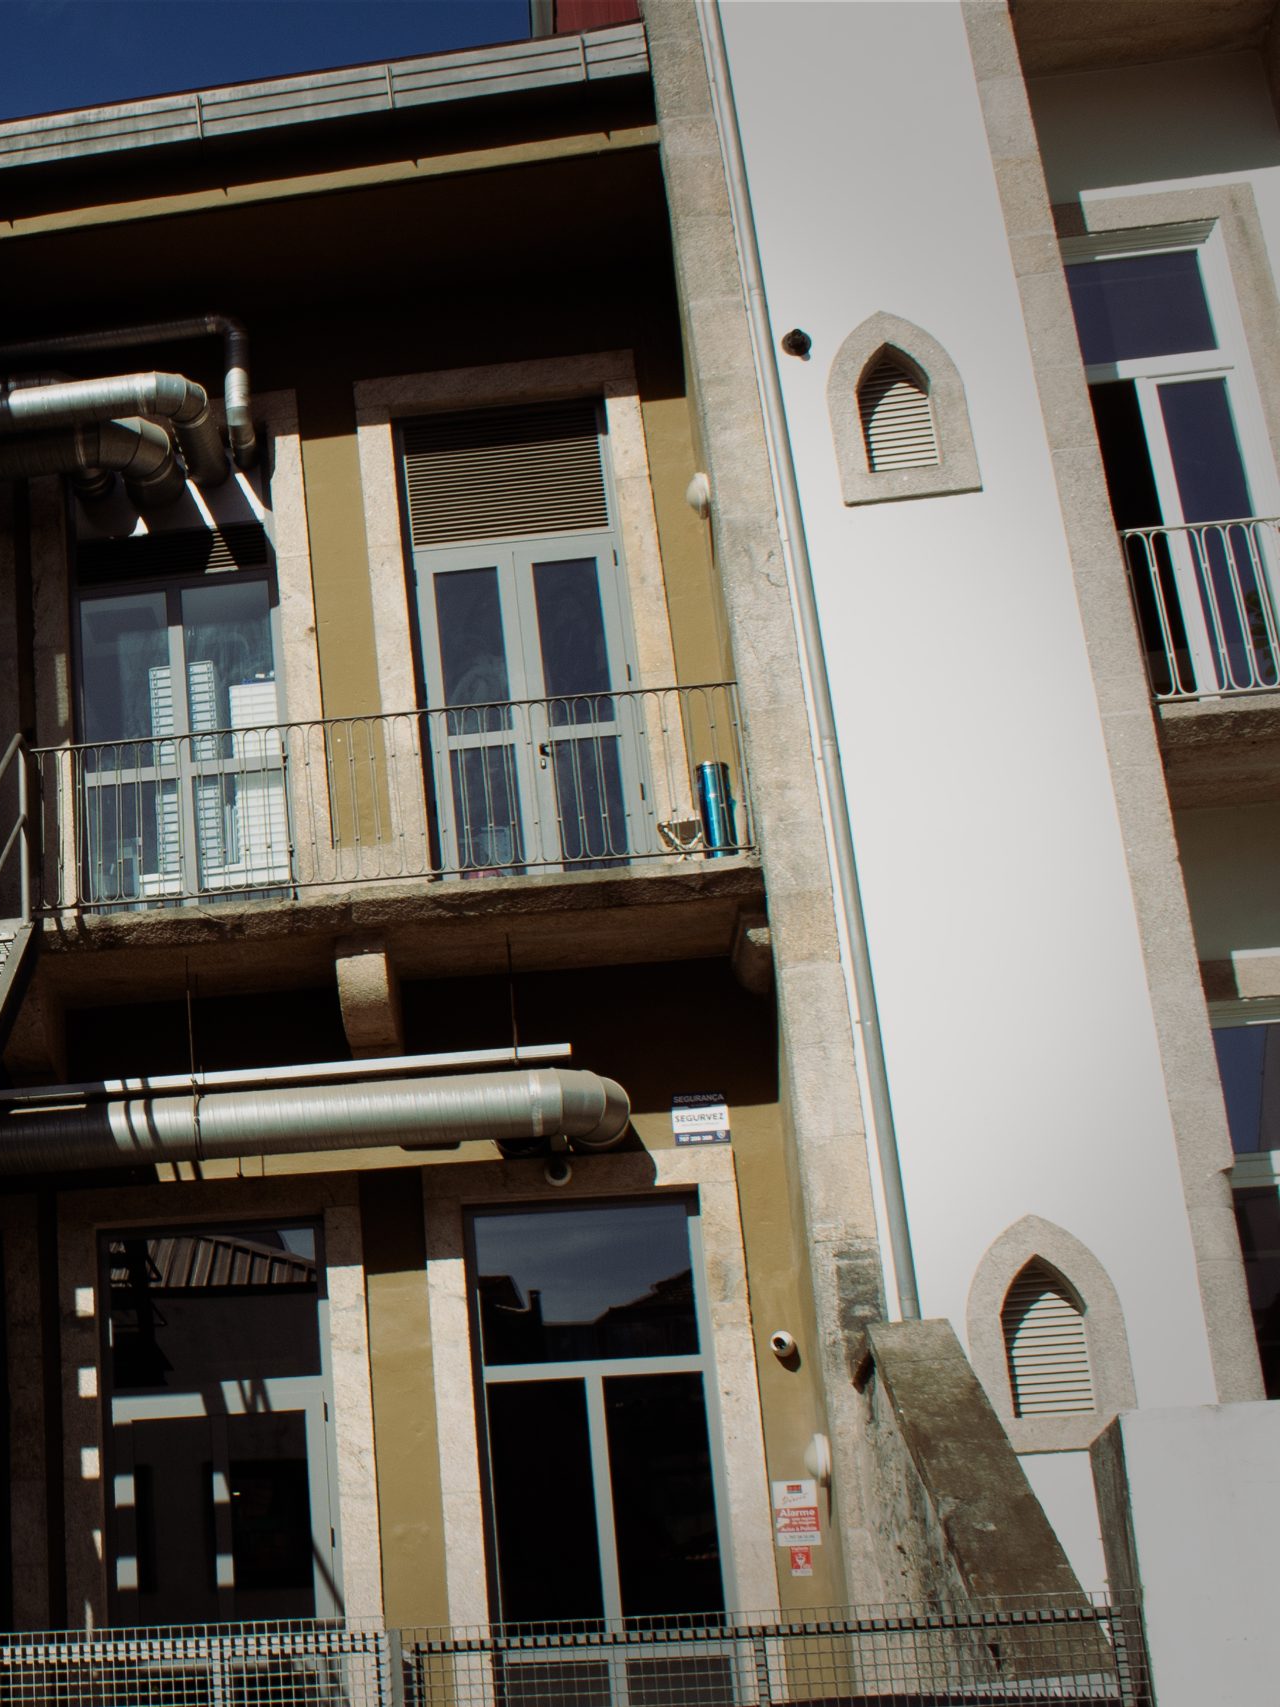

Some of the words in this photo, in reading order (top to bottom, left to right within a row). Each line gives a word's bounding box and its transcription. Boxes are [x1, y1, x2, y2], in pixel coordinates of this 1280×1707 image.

[673, 1093, 724, 1103] SEGURANÇA
[674, 1113, 724, 1122] SEGURVEZ
[780, 1508, 815, 1517] Alarme
